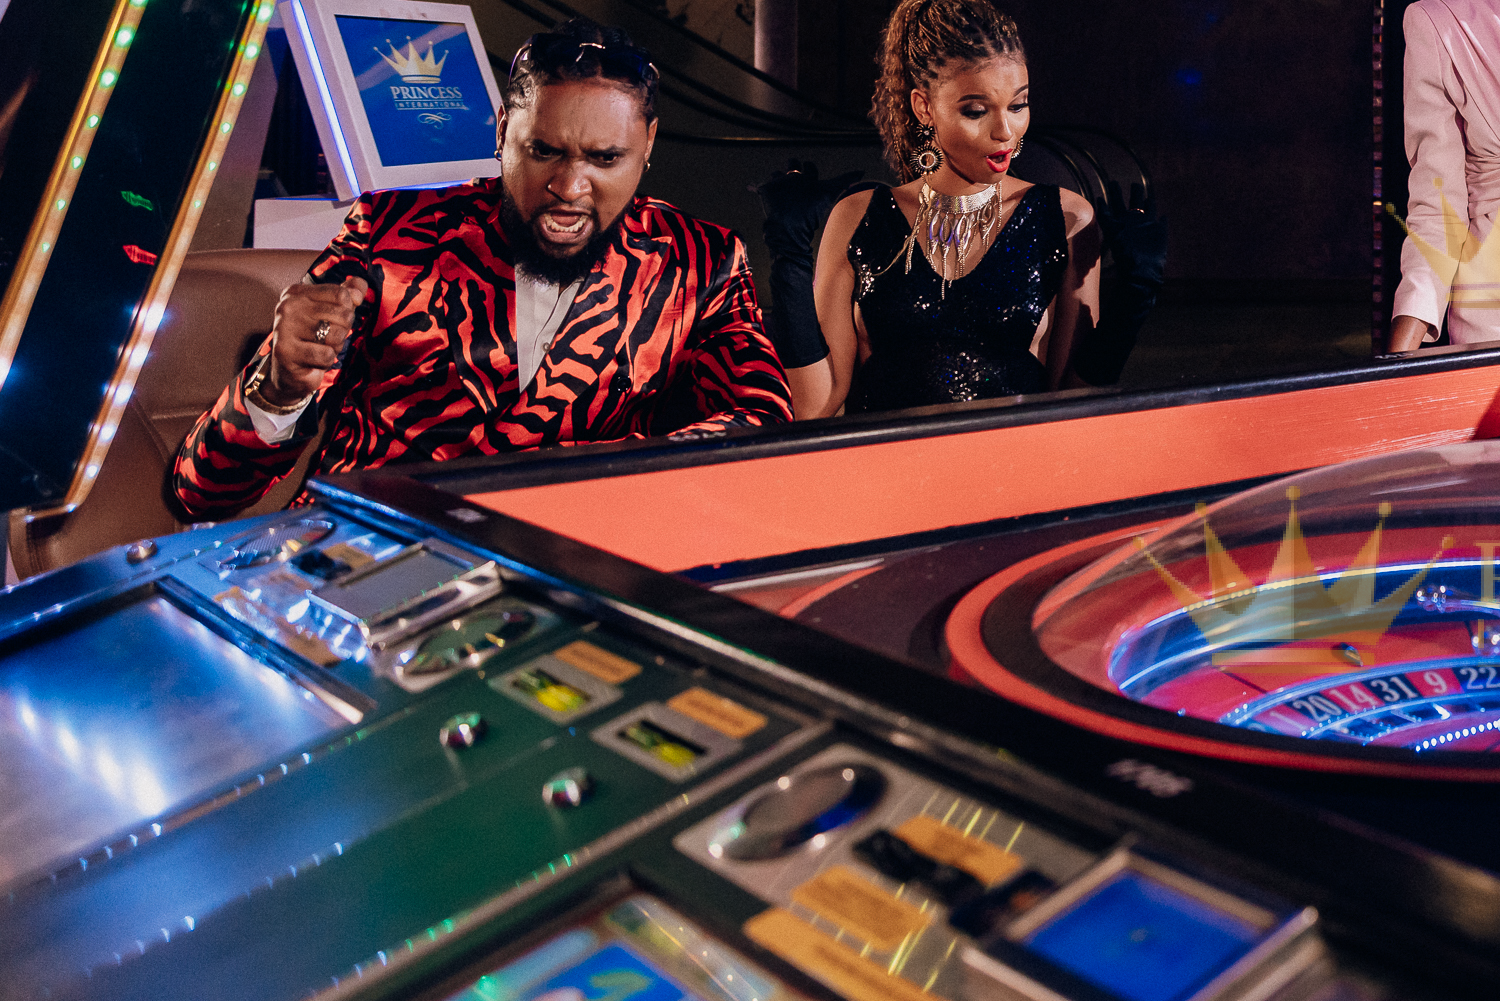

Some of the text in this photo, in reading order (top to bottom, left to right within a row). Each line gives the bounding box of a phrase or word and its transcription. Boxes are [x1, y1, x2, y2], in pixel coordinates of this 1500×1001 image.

[390, 86, 462, 99] PRINCESS
[395, 101, 463, 109] INTERNATIONAL
[1293, 694, 1343, 722] 20
[1329, 685, 1378, 713] 14
[1370, 675, 1419, 702] 31
[1424, 670, 1449, 694] 9
